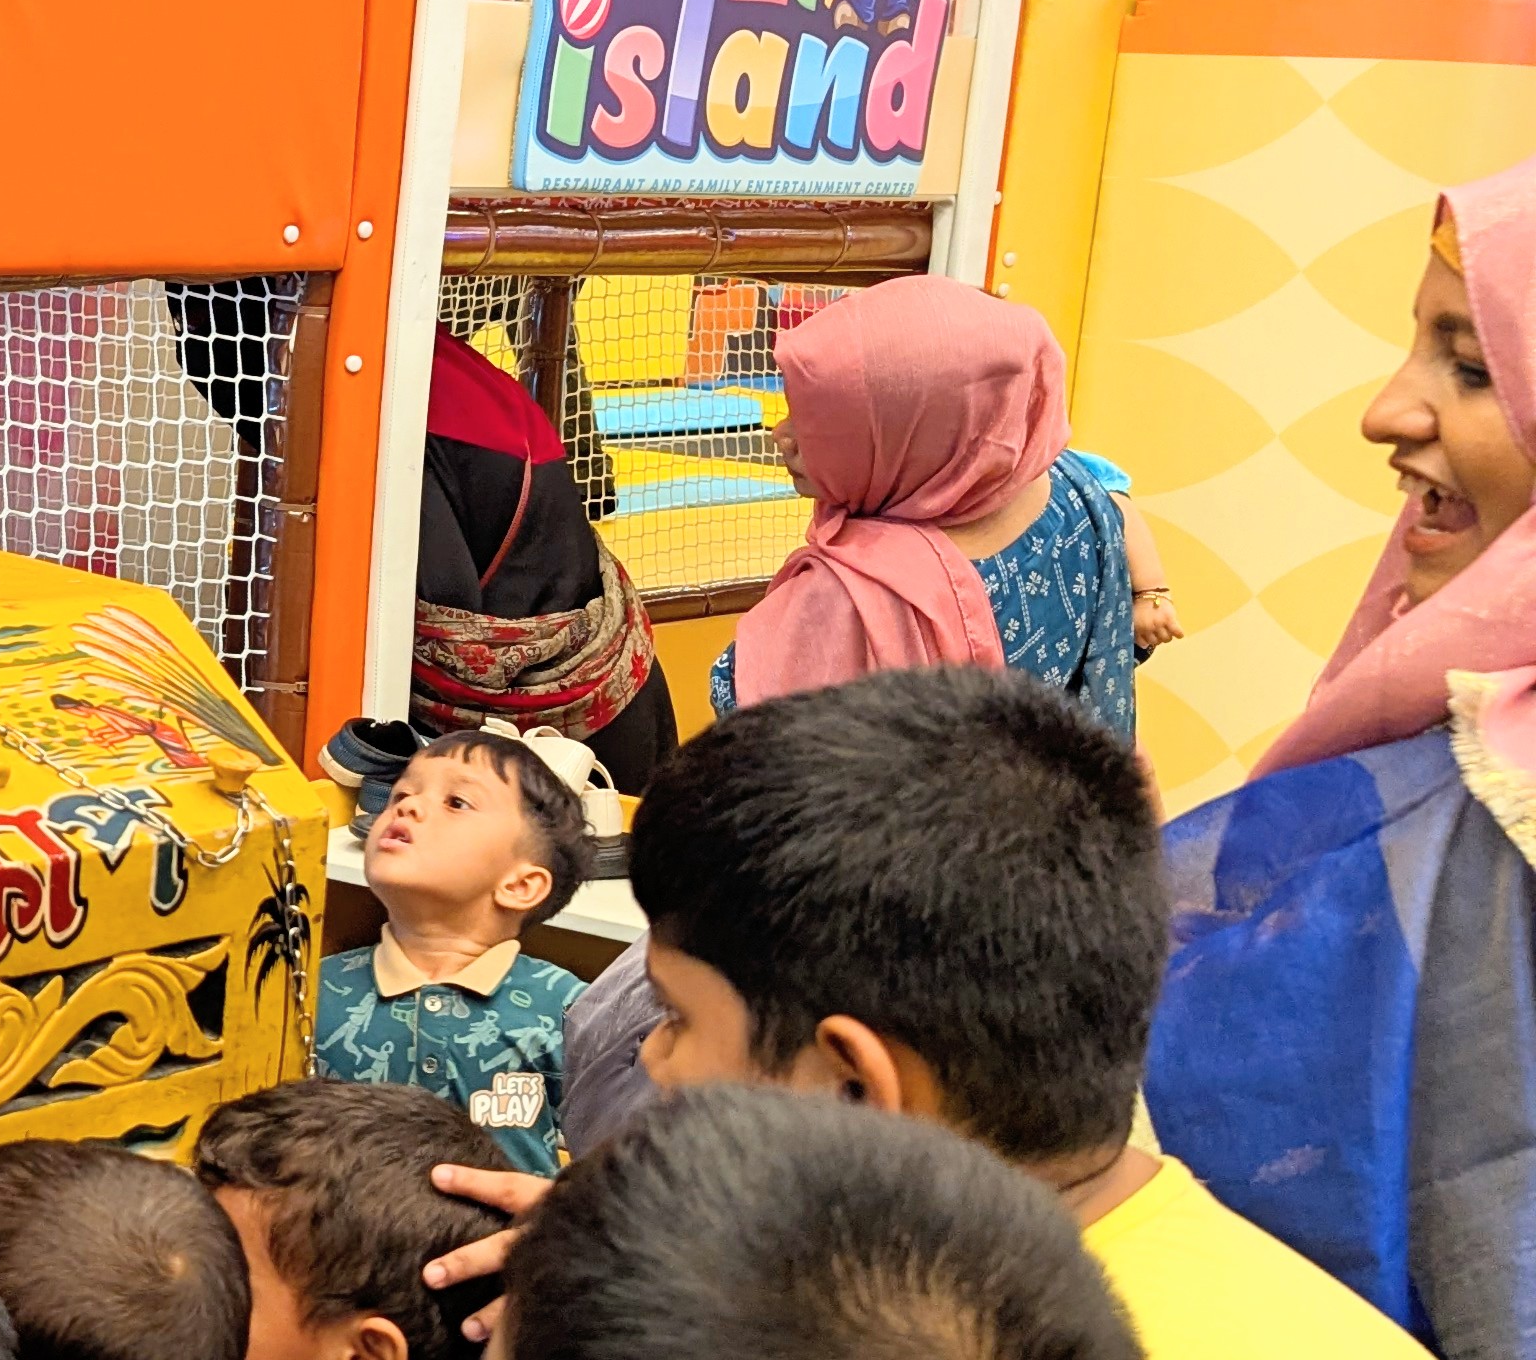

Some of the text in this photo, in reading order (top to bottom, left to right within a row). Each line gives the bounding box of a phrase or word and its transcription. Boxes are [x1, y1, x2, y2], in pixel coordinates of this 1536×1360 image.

[542, 177, 916, 196] RESTAURANT AND FAMILY ENTERTAINMENT CENTER
[496, 1077, 540, 1095] LET'S
[473, 1094, 541, 1124] PLAY
